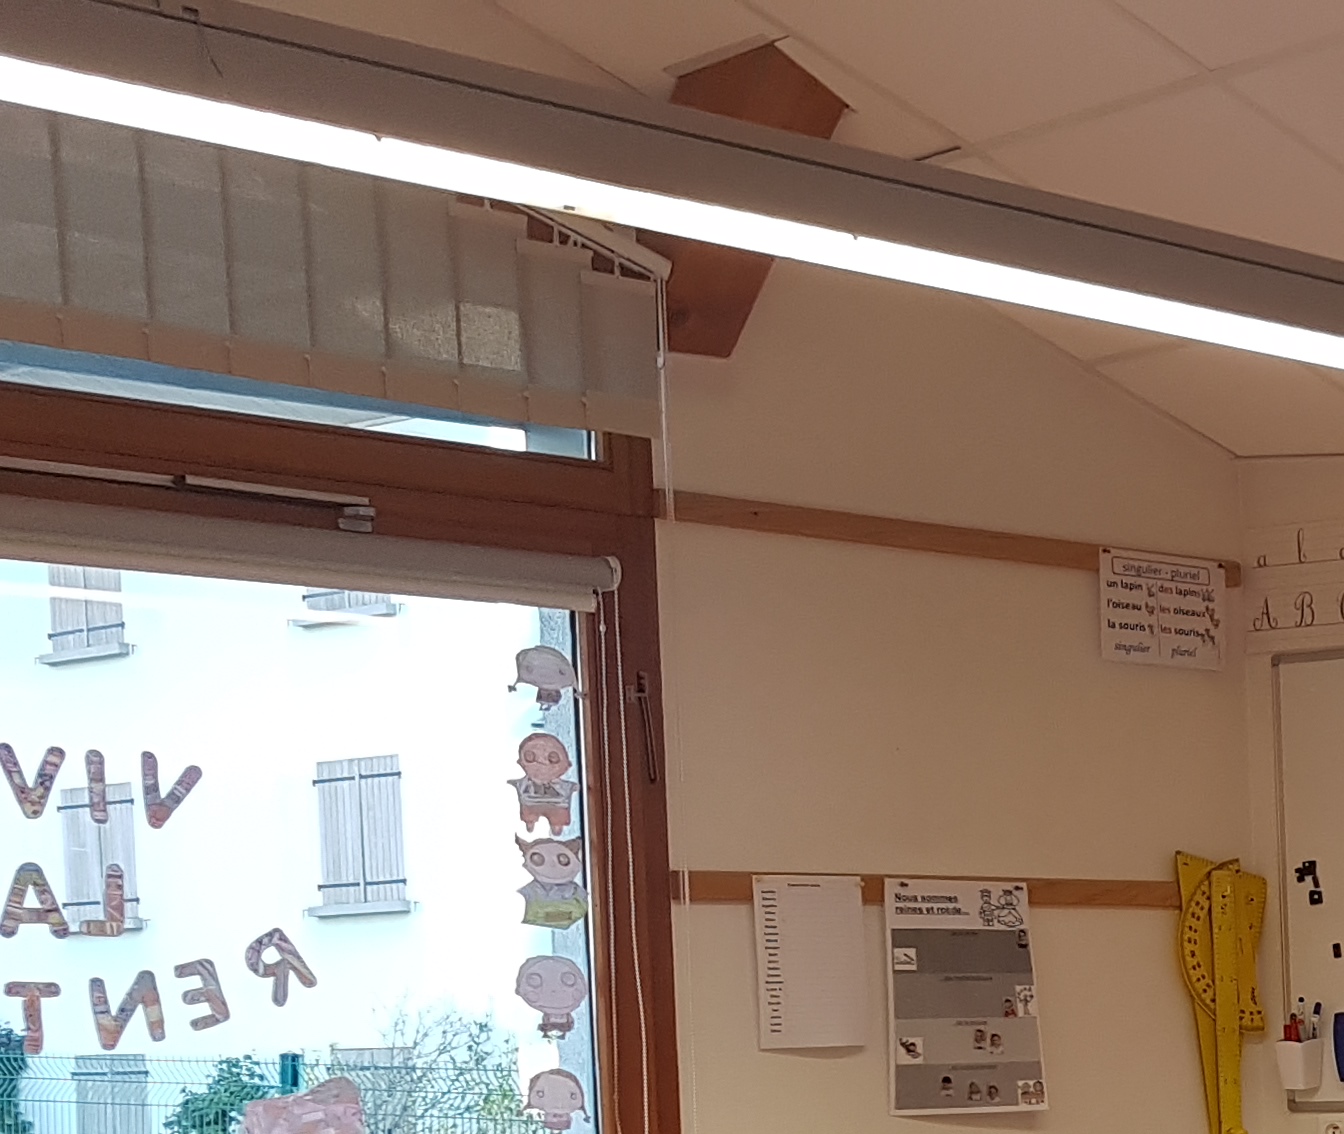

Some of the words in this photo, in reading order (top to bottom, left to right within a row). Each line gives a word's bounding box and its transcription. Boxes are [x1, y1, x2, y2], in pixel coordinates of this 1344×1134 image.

[1257, 555, 1267, 567] a
[1296, 528, 1307, 563] b
[1122, 561, 1162, 577] singulier
[1170, 569, 1200, 582] pluriel
[1106, 580, 1119, 588] un
[1120, 579, 1144, 592] lapin
[1158, 584, 1173, 595] des
[1107, 598, 1142, 611] l'oiseau
[1253, 596, 1278, 631] A
[1294, 591, 1315, 628] B
[1173, 606, 1206, 618] oiseaux
[1107, 618, 1116, 629] la
[1118, 622, 1147, 633] souris
[1160, 624, 1172, 635] les
[1174, 627, 1200, 638] souris
